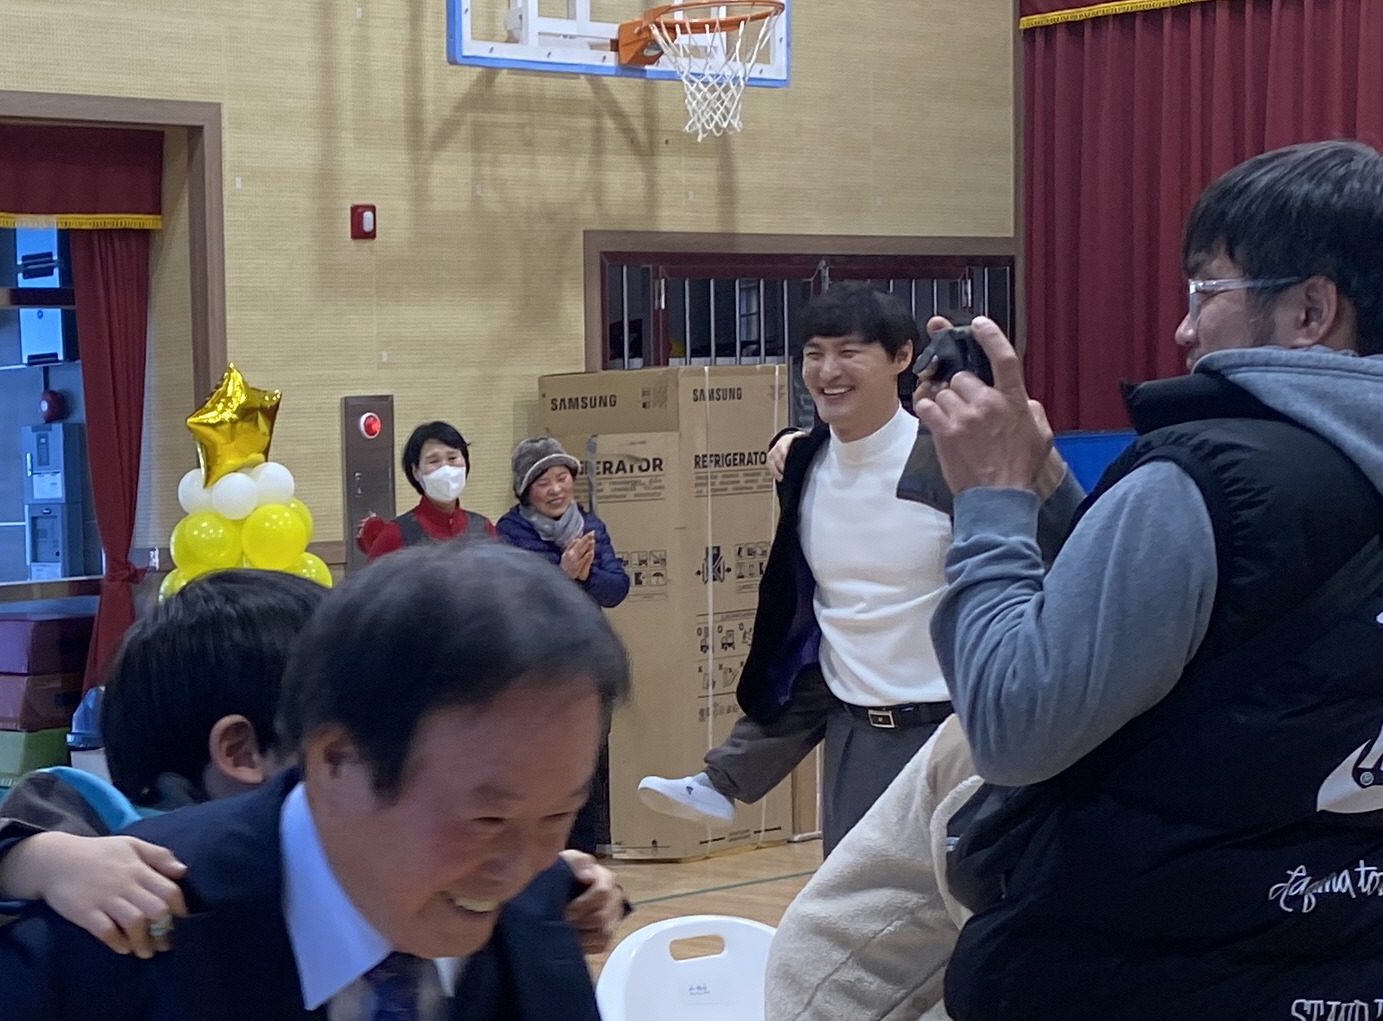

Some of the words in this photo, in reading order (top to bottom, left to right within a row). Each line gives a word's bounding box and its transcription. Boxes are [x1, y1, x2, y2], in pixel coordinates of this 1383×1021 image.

[550, 394, 617, 411] SAMSUNG
[692, 387, 742, 402] SAMSUNG
[694, 451, 768, 469] REFRIGERATO
